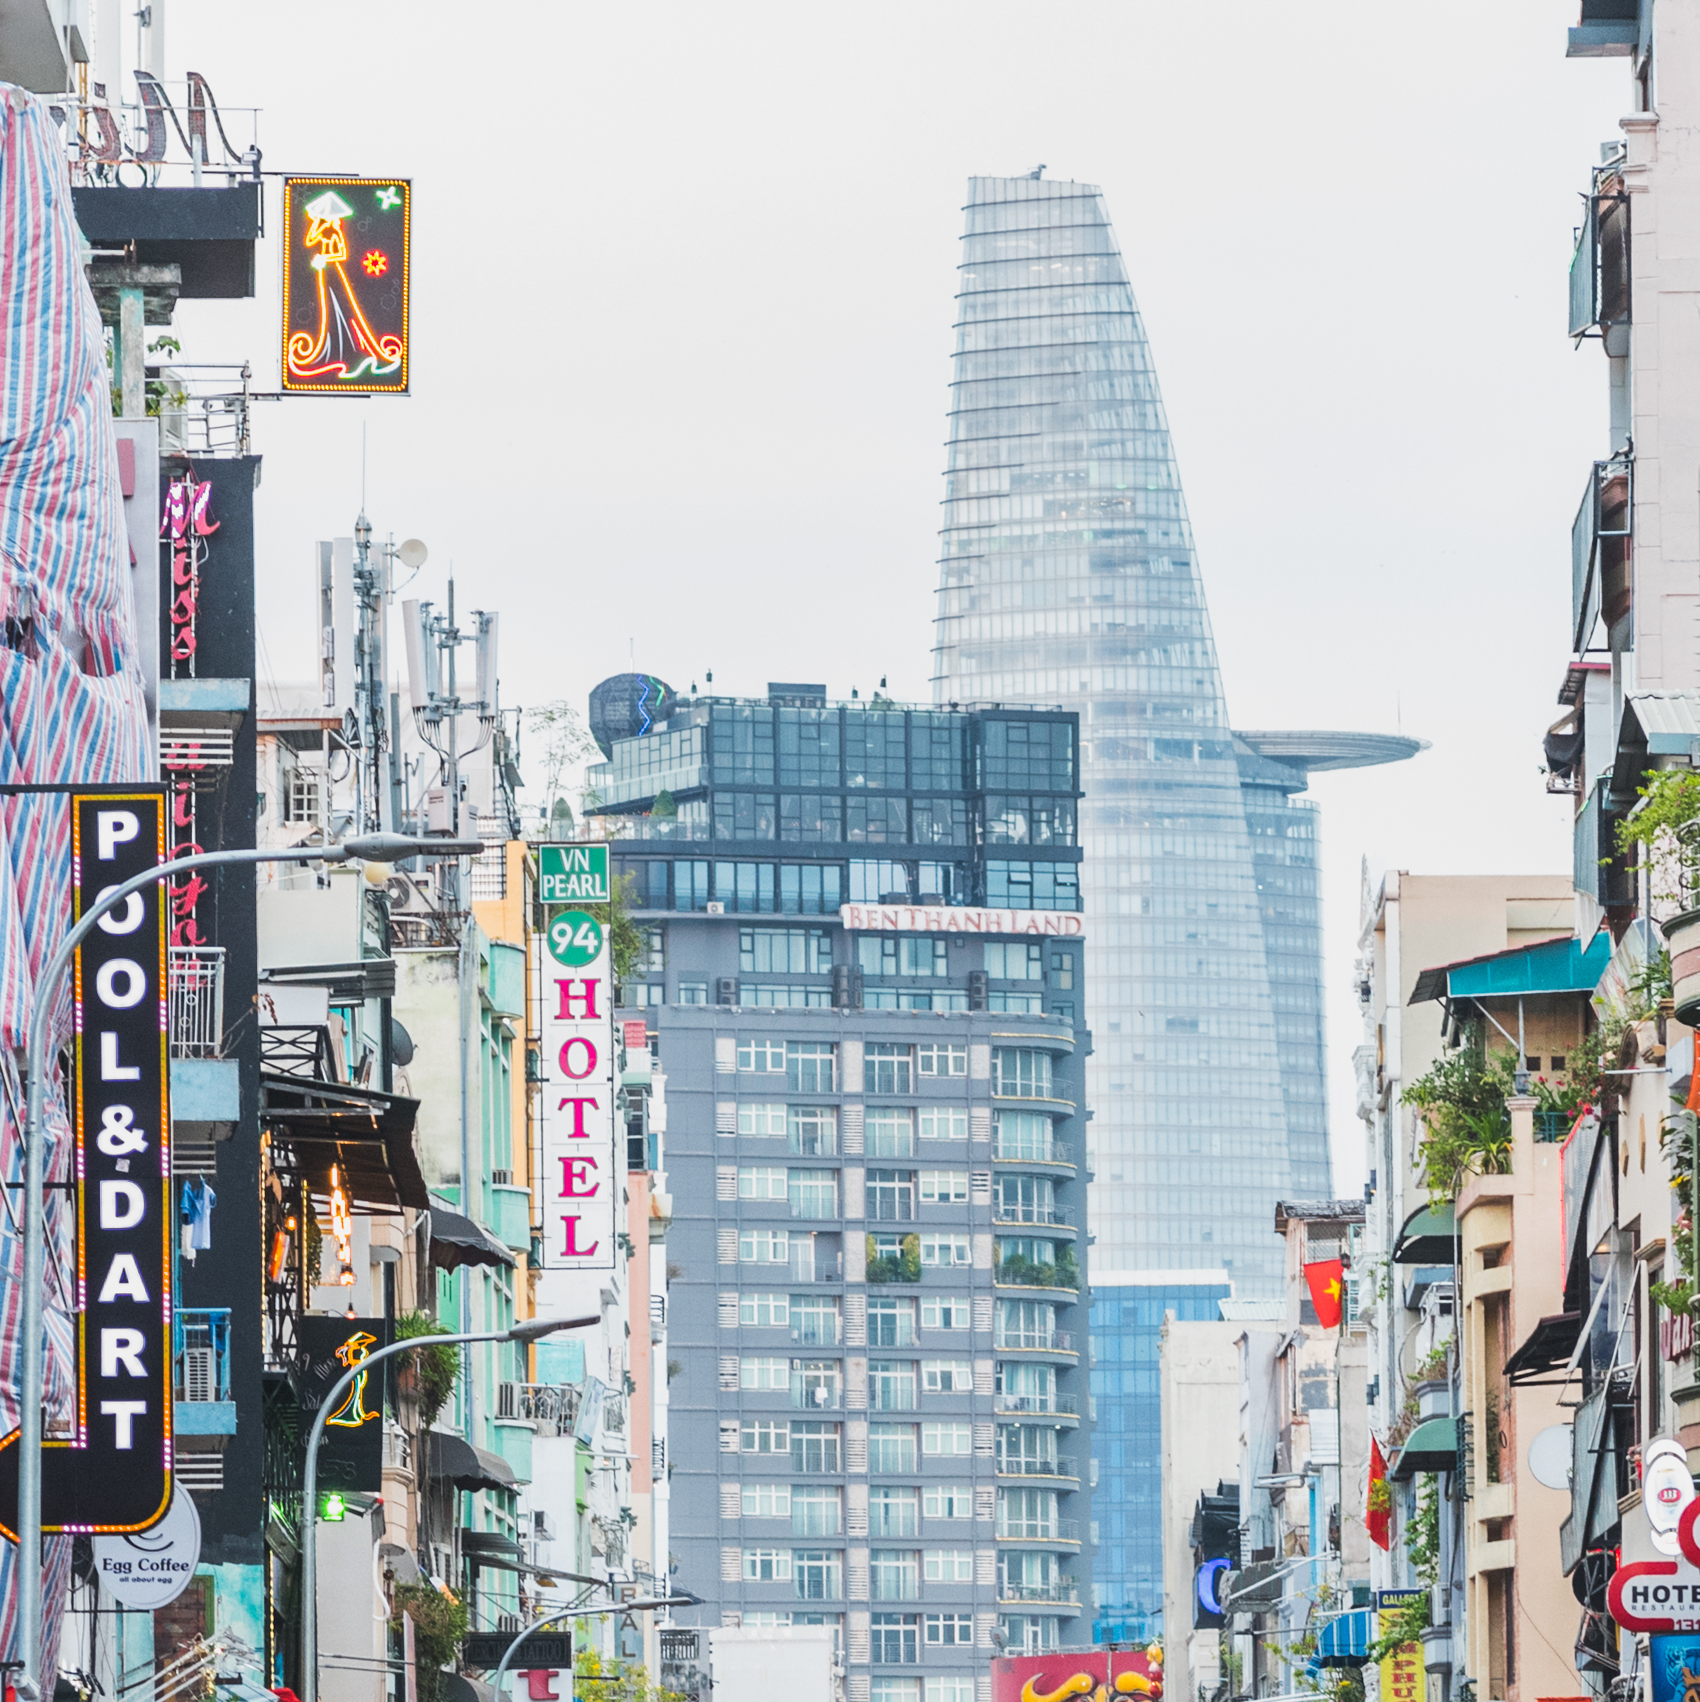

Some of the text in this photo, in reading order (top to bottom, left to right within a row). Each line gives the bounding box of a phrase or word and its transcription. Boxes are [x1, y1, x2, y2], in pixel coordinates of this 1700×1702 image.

[561, 846, 589, 872] VN
[542, 872, 608, 900] PEARL
[849, 906, 1082, 936] BEN THANH LAND
[549, 919, 601, 953] 94
[96, 811, 150, 1450] POOL&DART
[552, 977, 601, 1259] HOTEL
[1661, 1490, 1677, 1500] 333
[102, 1557, 190, 1574] Egg Coffee
[157, 1577, 173, 1585] egg
